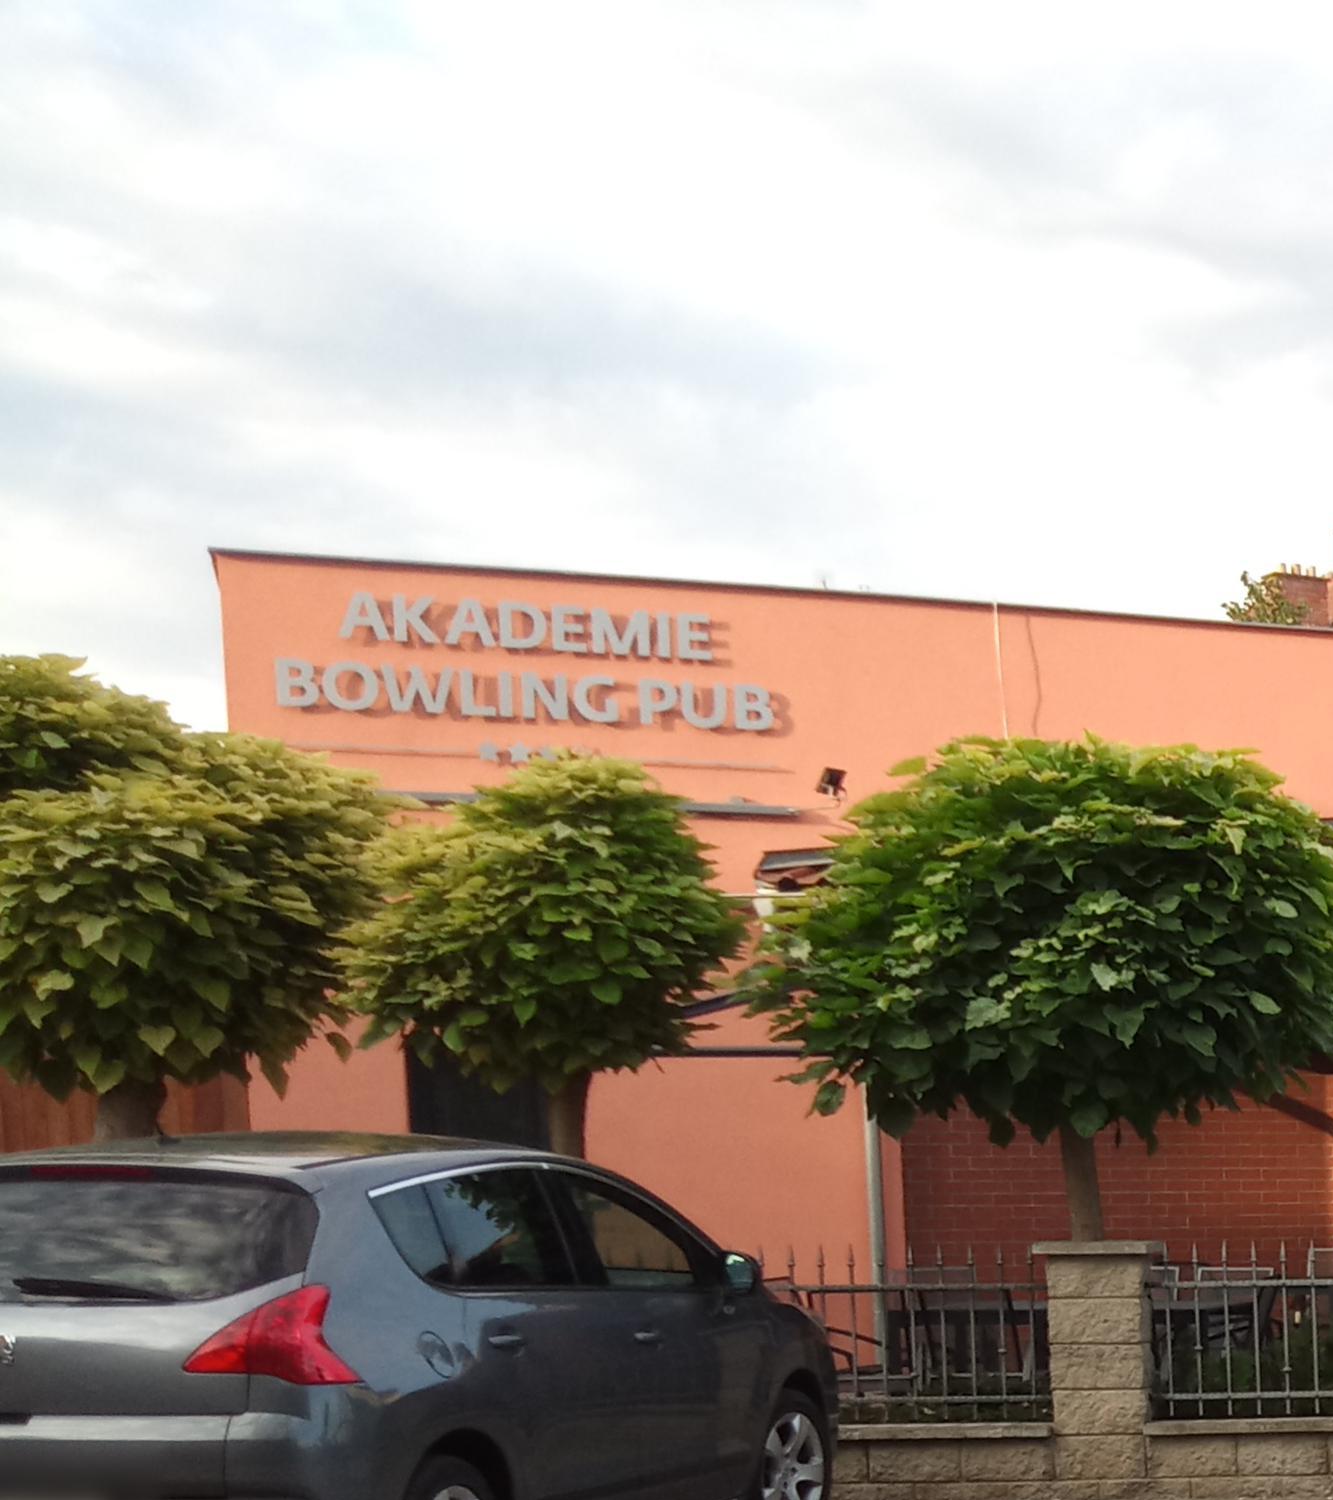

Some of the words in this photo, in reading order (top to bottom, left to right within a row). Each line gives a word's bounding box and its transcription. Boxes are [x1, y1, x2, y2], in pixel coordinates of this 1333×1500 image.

[339, 592, 713, 662] AKADEMIE
[275, 657, 620, 724] BOWLING
[638, 677, 775, 732] PUB
